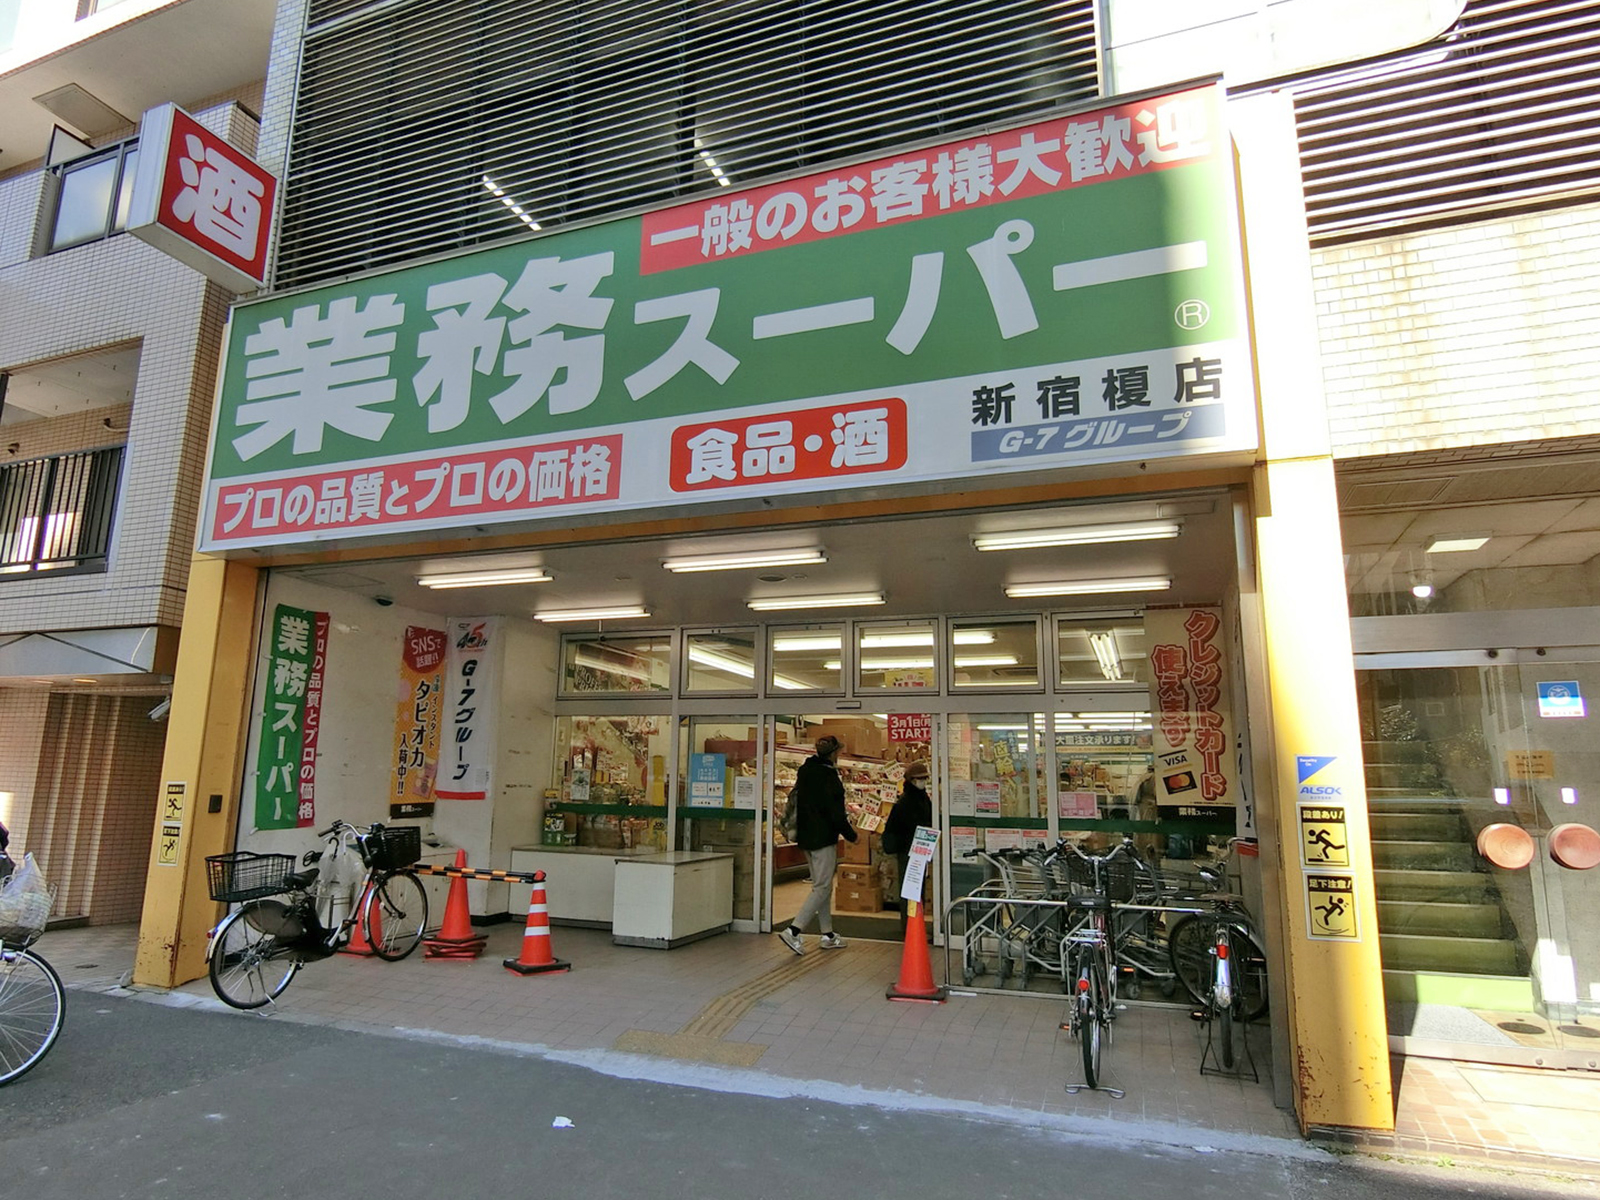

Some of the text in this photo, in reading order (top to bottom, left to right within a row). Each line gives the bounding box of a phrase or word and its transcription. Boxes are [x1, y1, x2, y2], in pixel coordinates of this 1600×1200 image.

[173, 133, 265, 262] 酒
[650, 100, 1211, 257] 一般のお客様大歓迎
[231, 219, 1208, 462] 業務スーパー
[971, 357, 1222, 426] 新宿榎店
[223, 444, 611, 533] プロの品質とプロの価格
[686, 406, 889, 485] 食品・酒
[411, 635, 442, 655] SNSで
[264, 614, 310, 820] 業務スーパー
[298, 620, 329, 820] プロの品質とプロの価格
[409, 680, 431, 768] タピオカ
[1151, 645, 1190, 747] 使えます
[1184, 610, 1227, 800] クレジットカード
[397, 733, 409, 795] 入荷中!!
[1164, 755, 1187, 766] VISA
[1300, 786, 1342, 796] ALSOK
